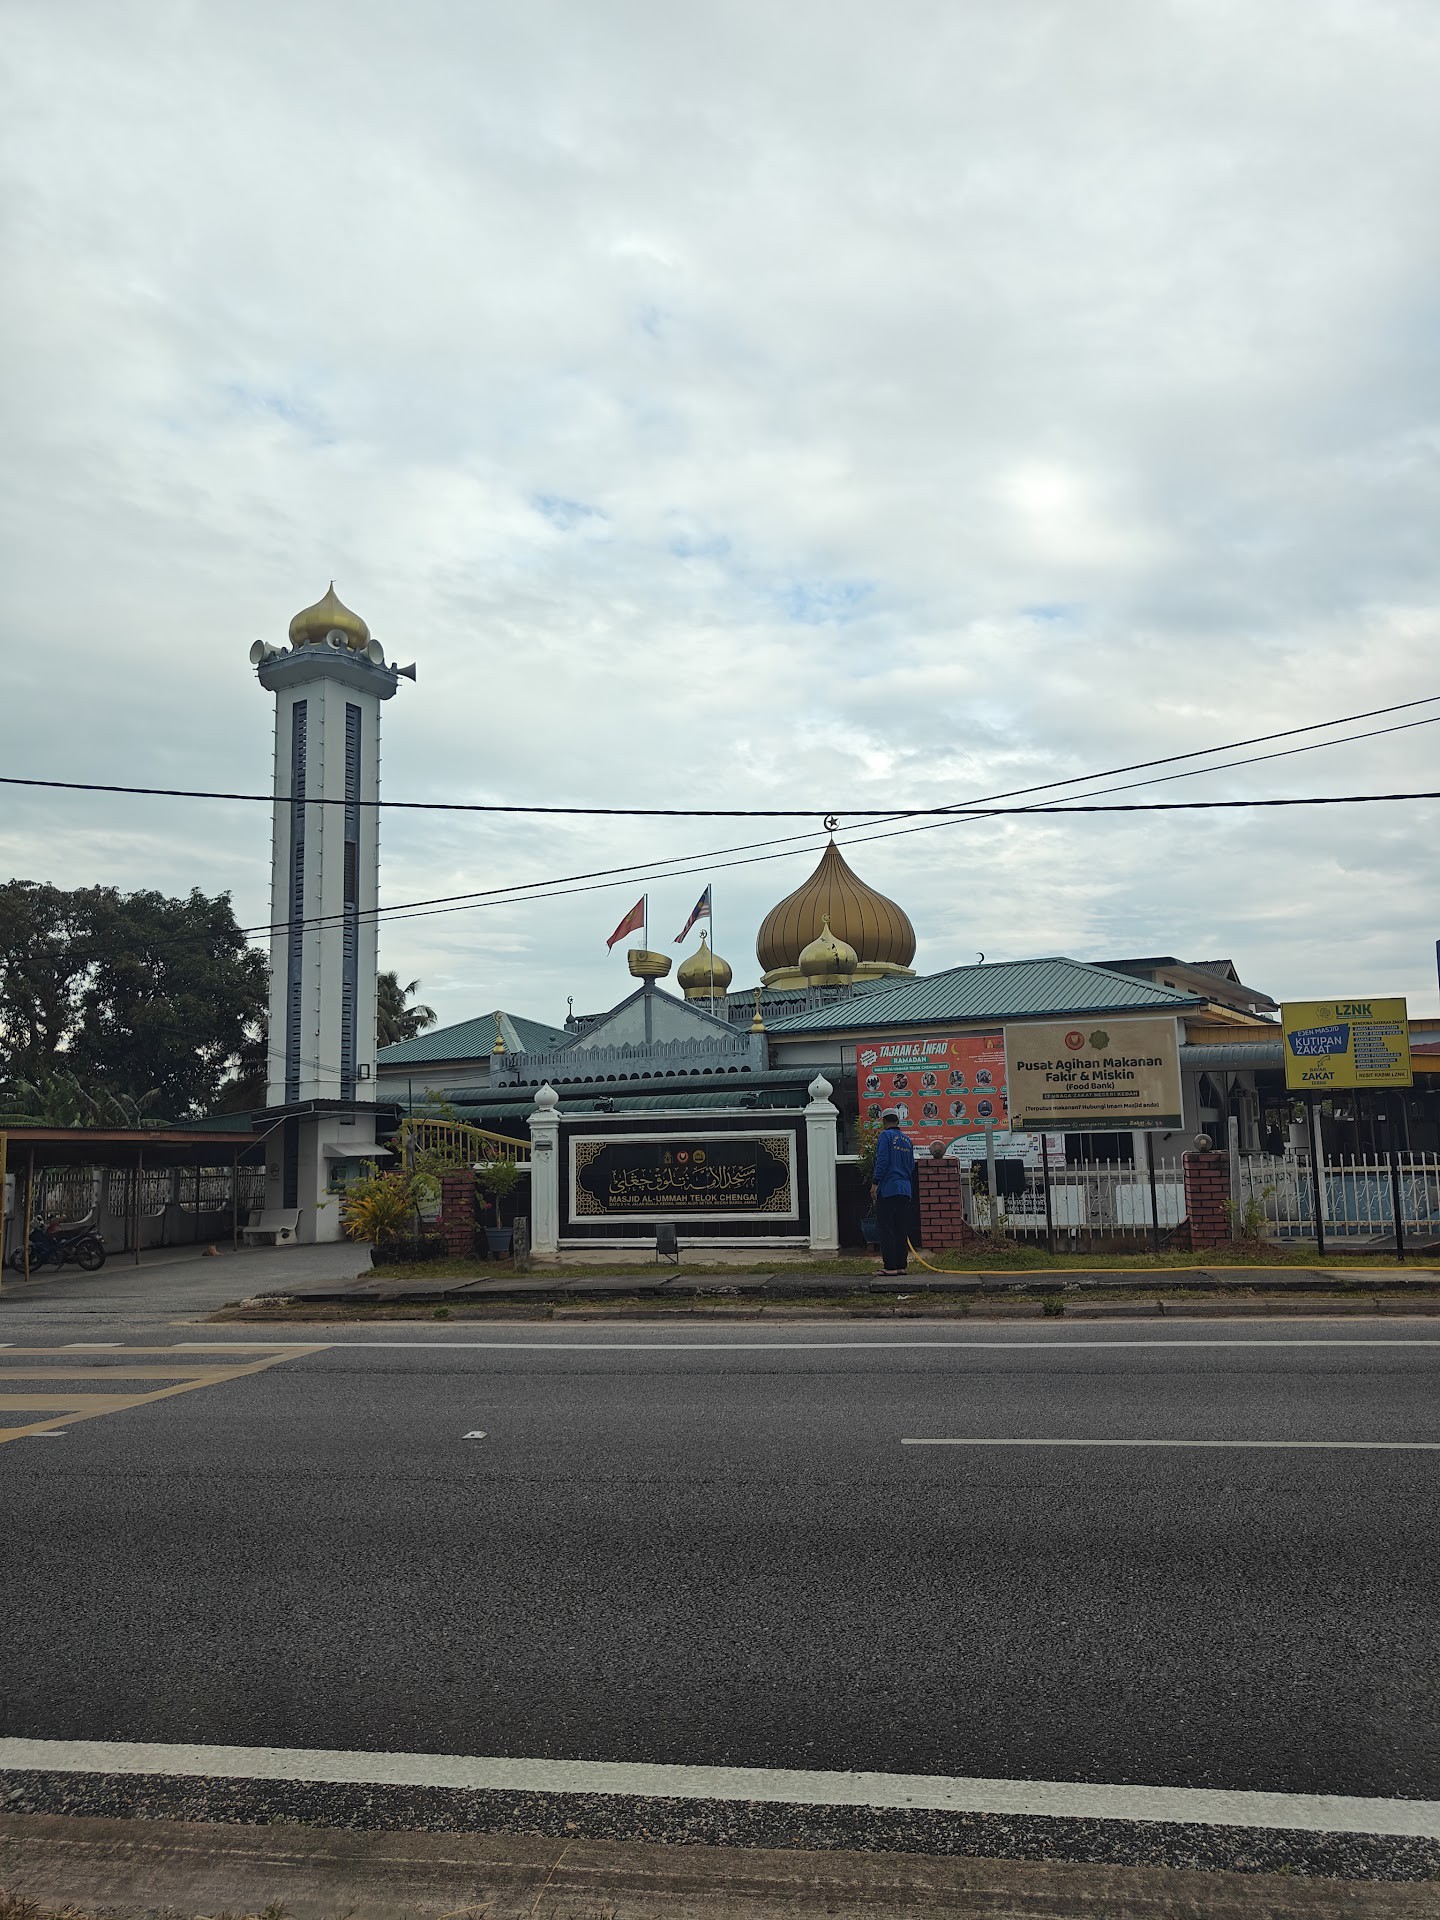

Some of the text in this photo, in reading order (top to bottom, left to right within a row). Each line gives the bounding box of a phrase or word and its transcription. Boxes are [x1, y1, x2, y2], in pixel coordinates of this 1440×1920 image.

[1335, 1004, 1372, 1015] LZNK
[1315, 1026, 1339, 1034] MASJID
[1295, 1036, 1342, 1046] KUTIPAN
[879, 1040, 948, 1057] TAJAAN & INFAQ
[1296, 1045, 1331, 1054] ZAKAT
[893, 1056, 927, 1064] RAMADAN
[1017, 1057, 1163, 1073] Pusat Agihan Makanan
[1045, 1069, 1135, 1082] Fakir & Miskin
[1302, 1072, 1335, 1081] ZAKAT
[1066, 1082, 1115, 1092] (Food Bank)
[1082, 1103, 1106, 1111] Hubungi
[609, 1195, 640, 1203] MASJID
[719, 1193, 758, 1201] CHENGAI
